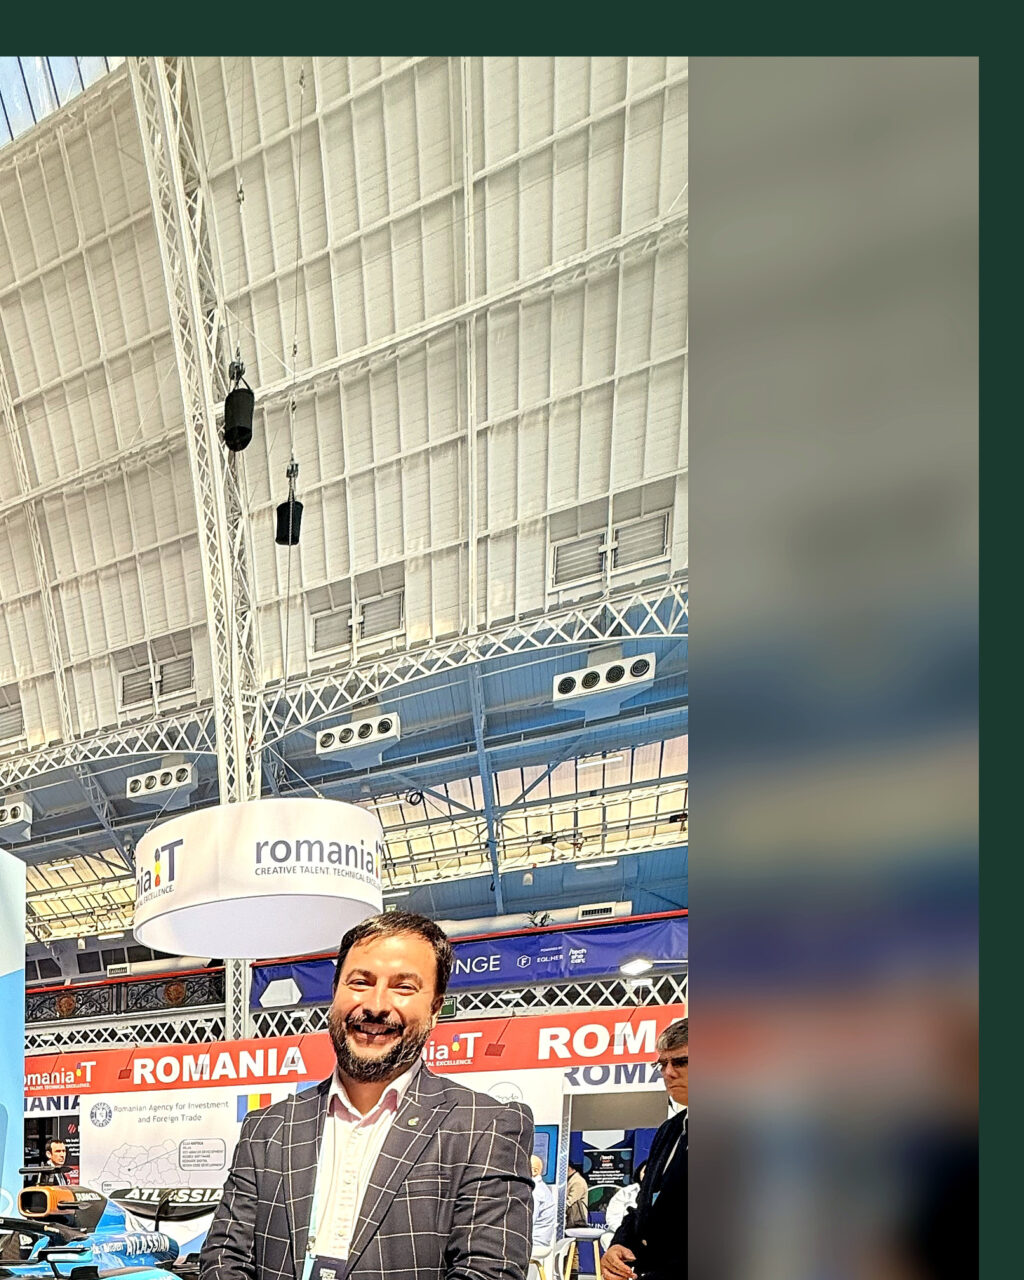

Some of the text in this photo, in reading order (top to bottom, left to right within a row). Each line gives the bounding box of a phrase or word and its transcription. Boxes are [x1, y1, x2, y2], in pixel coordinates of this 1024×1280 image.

[254, 865, 297, 876] CREATIVE
[451, 955, 501, 975] NGE
[538, 1018, 682, 1060] ROM
[132, 1046, 307, 1085] ROMANIA
[24, 1094, 80, 1112] ANIA
[113, 1101, 229, 1113] Romanian Agency for Investment
[137, 1113, 202, 1124] and Foreign Trade
